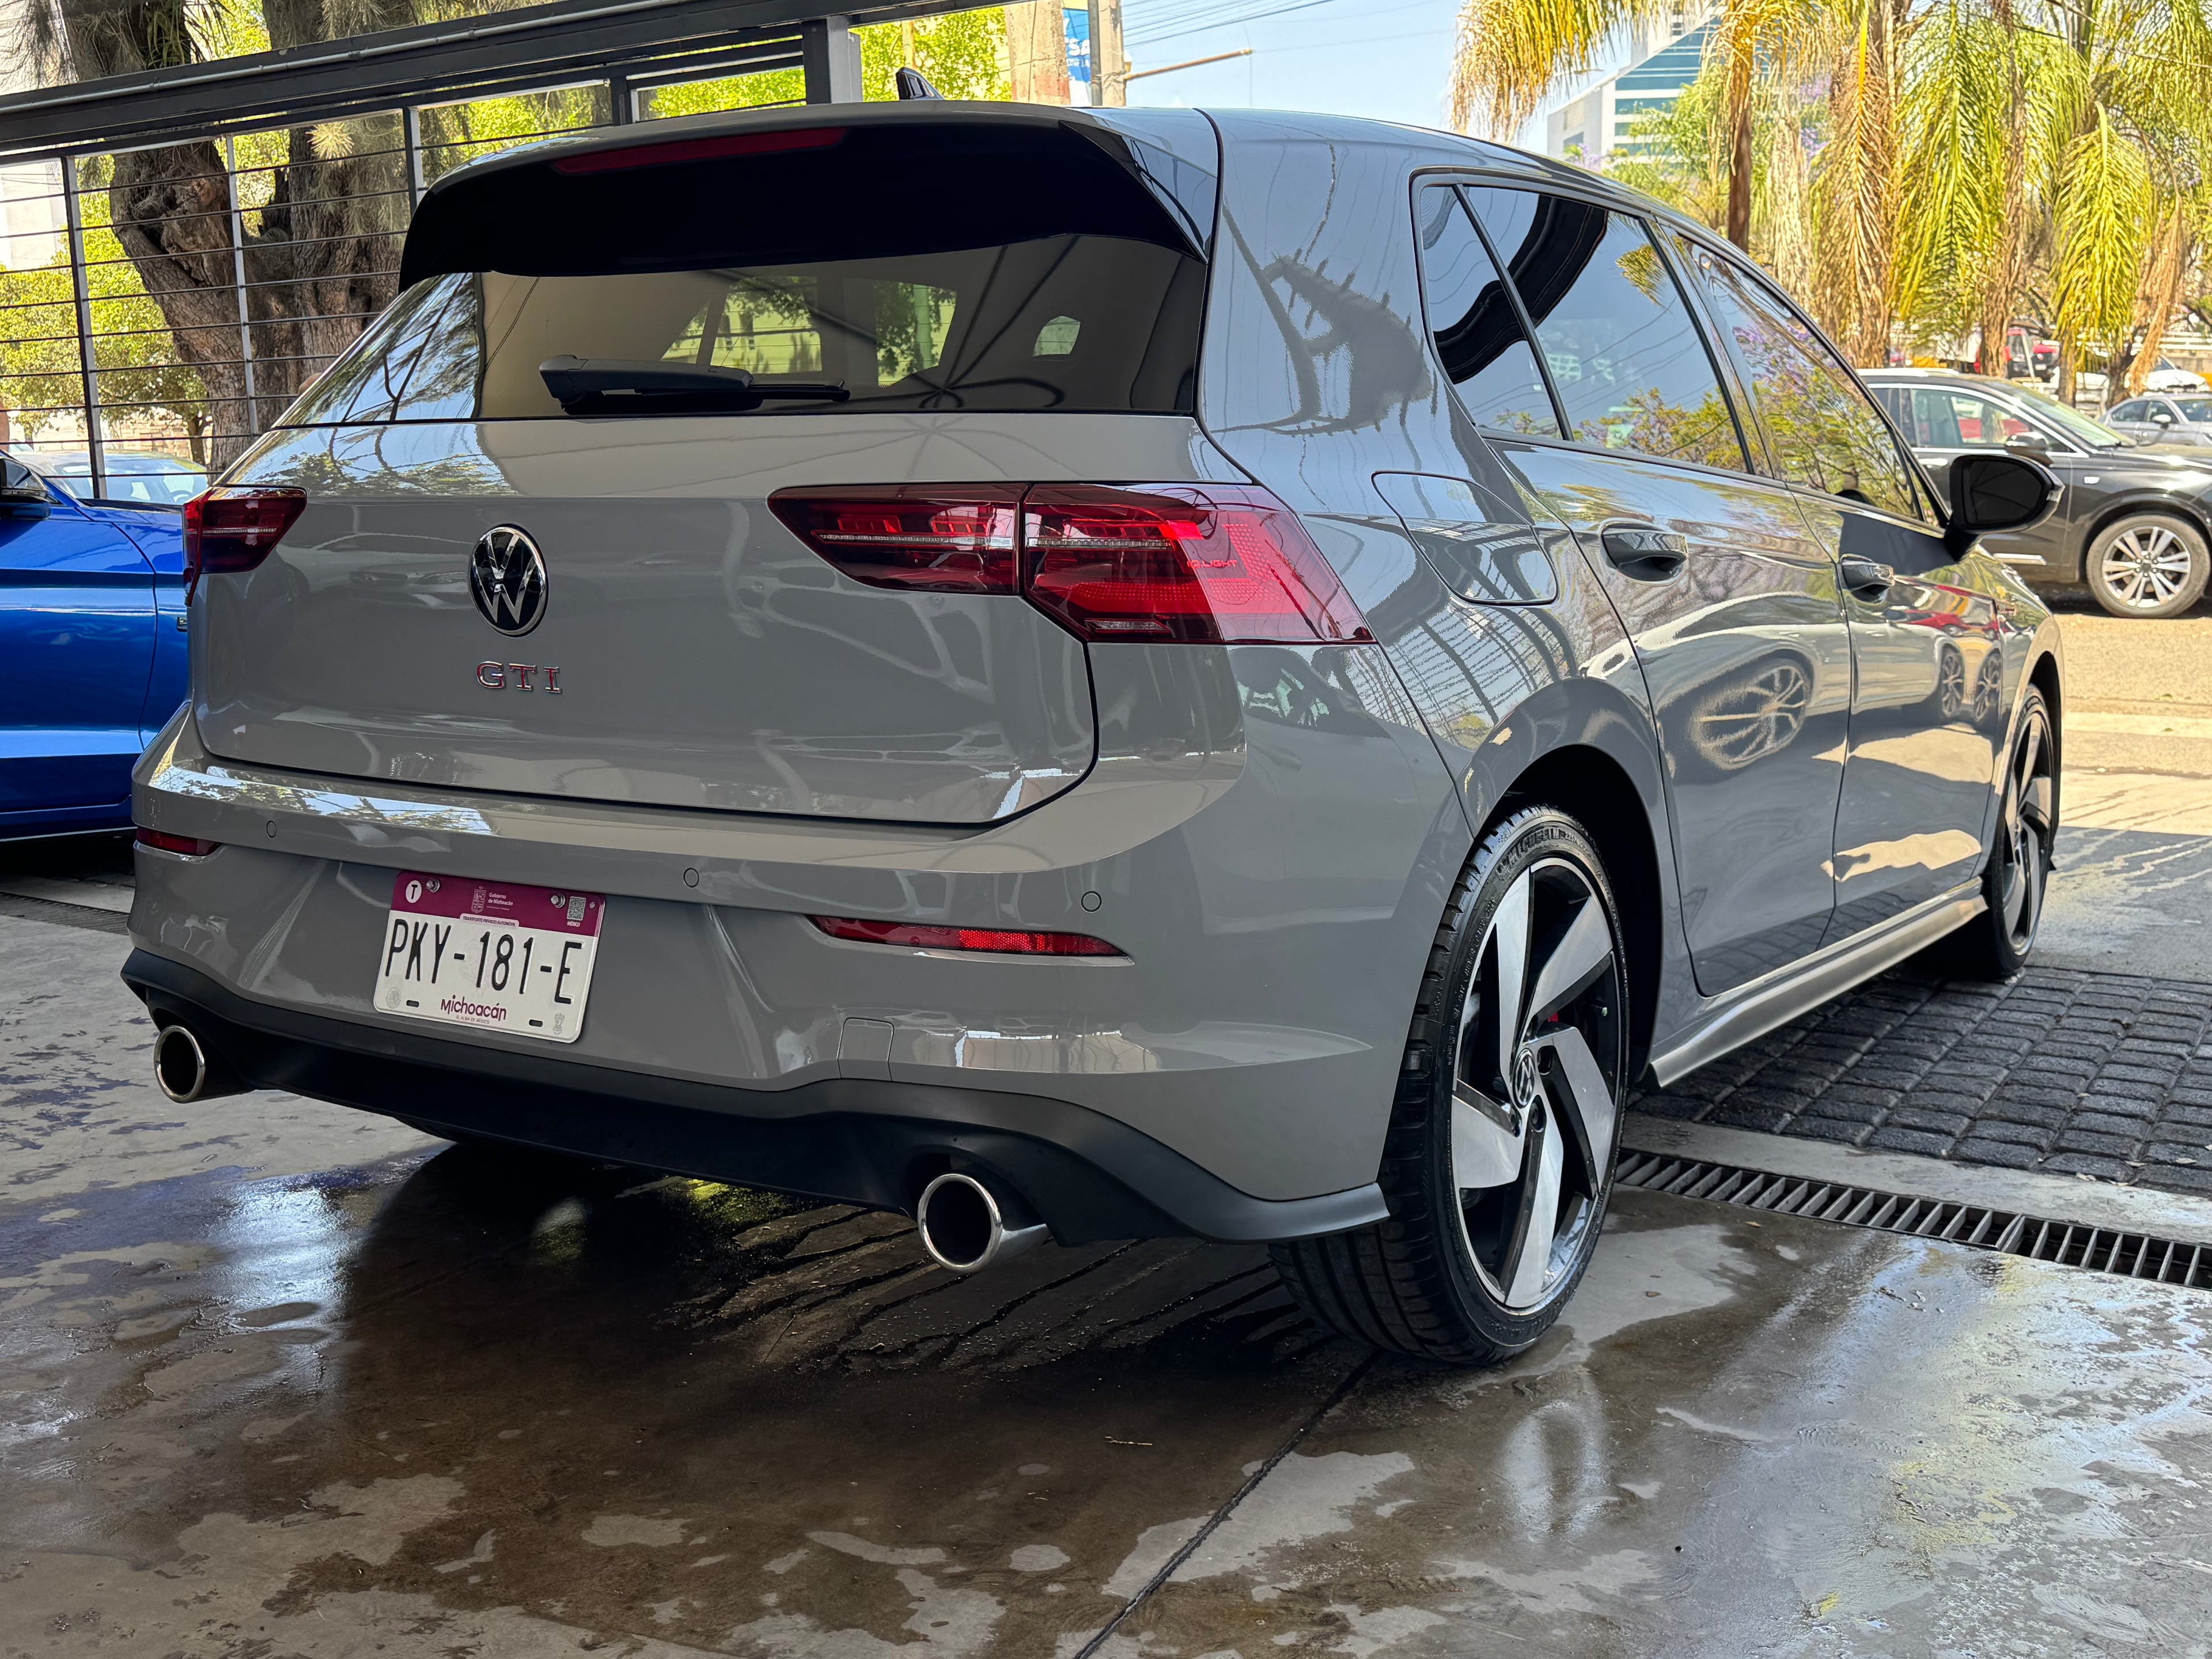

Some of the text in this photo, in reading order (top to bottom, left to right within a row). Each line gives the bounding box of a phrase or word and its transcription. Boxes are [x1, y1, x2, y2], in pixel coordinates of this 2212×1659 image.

[476, 661, 562, 694] GTI
[411, 884, 418, 899] T
[385, 918, 583, 1005] PKY-181-E
[440, 995, 507, 1021] Michoacán
